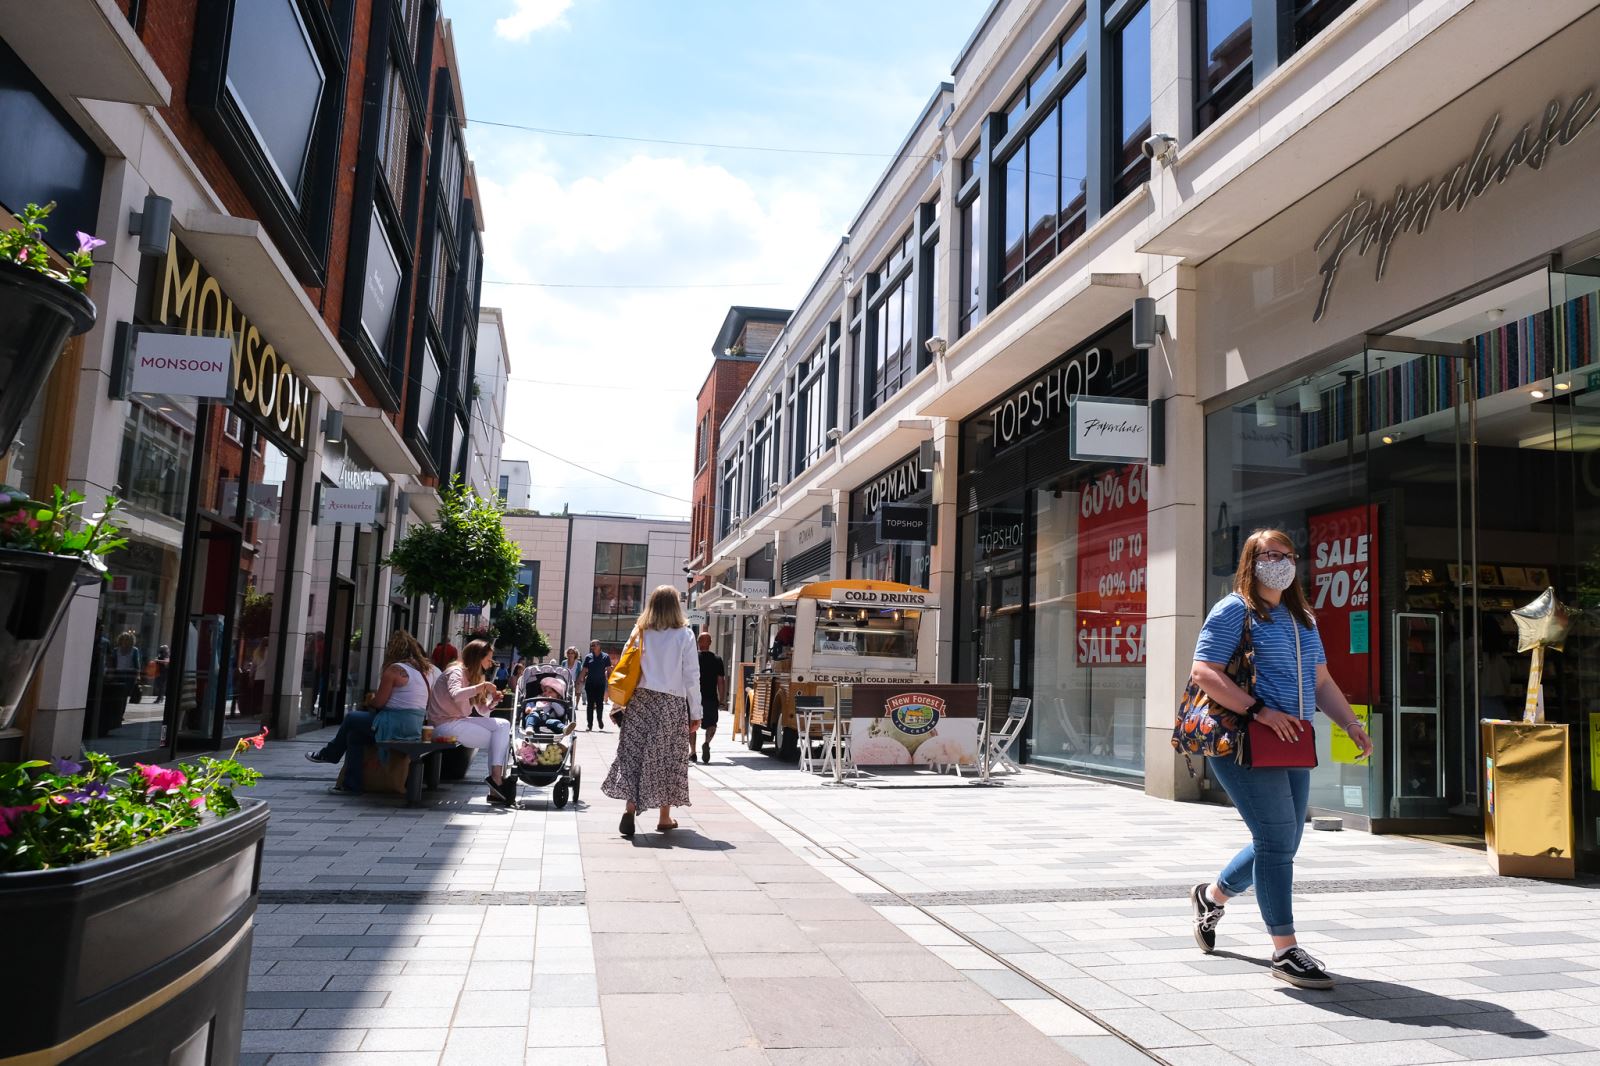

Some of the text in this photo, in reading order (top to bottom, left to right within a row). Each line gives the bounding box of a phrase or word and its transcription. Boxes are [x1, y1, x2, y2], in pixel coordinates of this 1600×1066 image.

[160, 232, 310, 448] MONSOON
[141, 356, 223, 372] MONSOON
[990, 347, 1100, 448] TOPSHOP
[1084, 419, 1143, 437] Paperchase
[864, 457, 918, 515] TOPMAN
[1081, 474, 1124, 518] 60%
[329, 500, 372, 510] Accessorize
[886, 519, 923, 528] TOPSHOP
[1109, 533, 1142, 562] UP TO
[1315, 533, 1369, 569] SALE
[1099, 571, 1126, 597] 60%
[845, 591, 925, 604] COLD DRINKS
[1351, 593, 1368, 606] OFF
[1079, 625, 1121, 664] SALE
[814, 674, 829, 682] ICE
[831, 675, 862, 683] CREAM
[891, 695, 940, 707] New Forest
